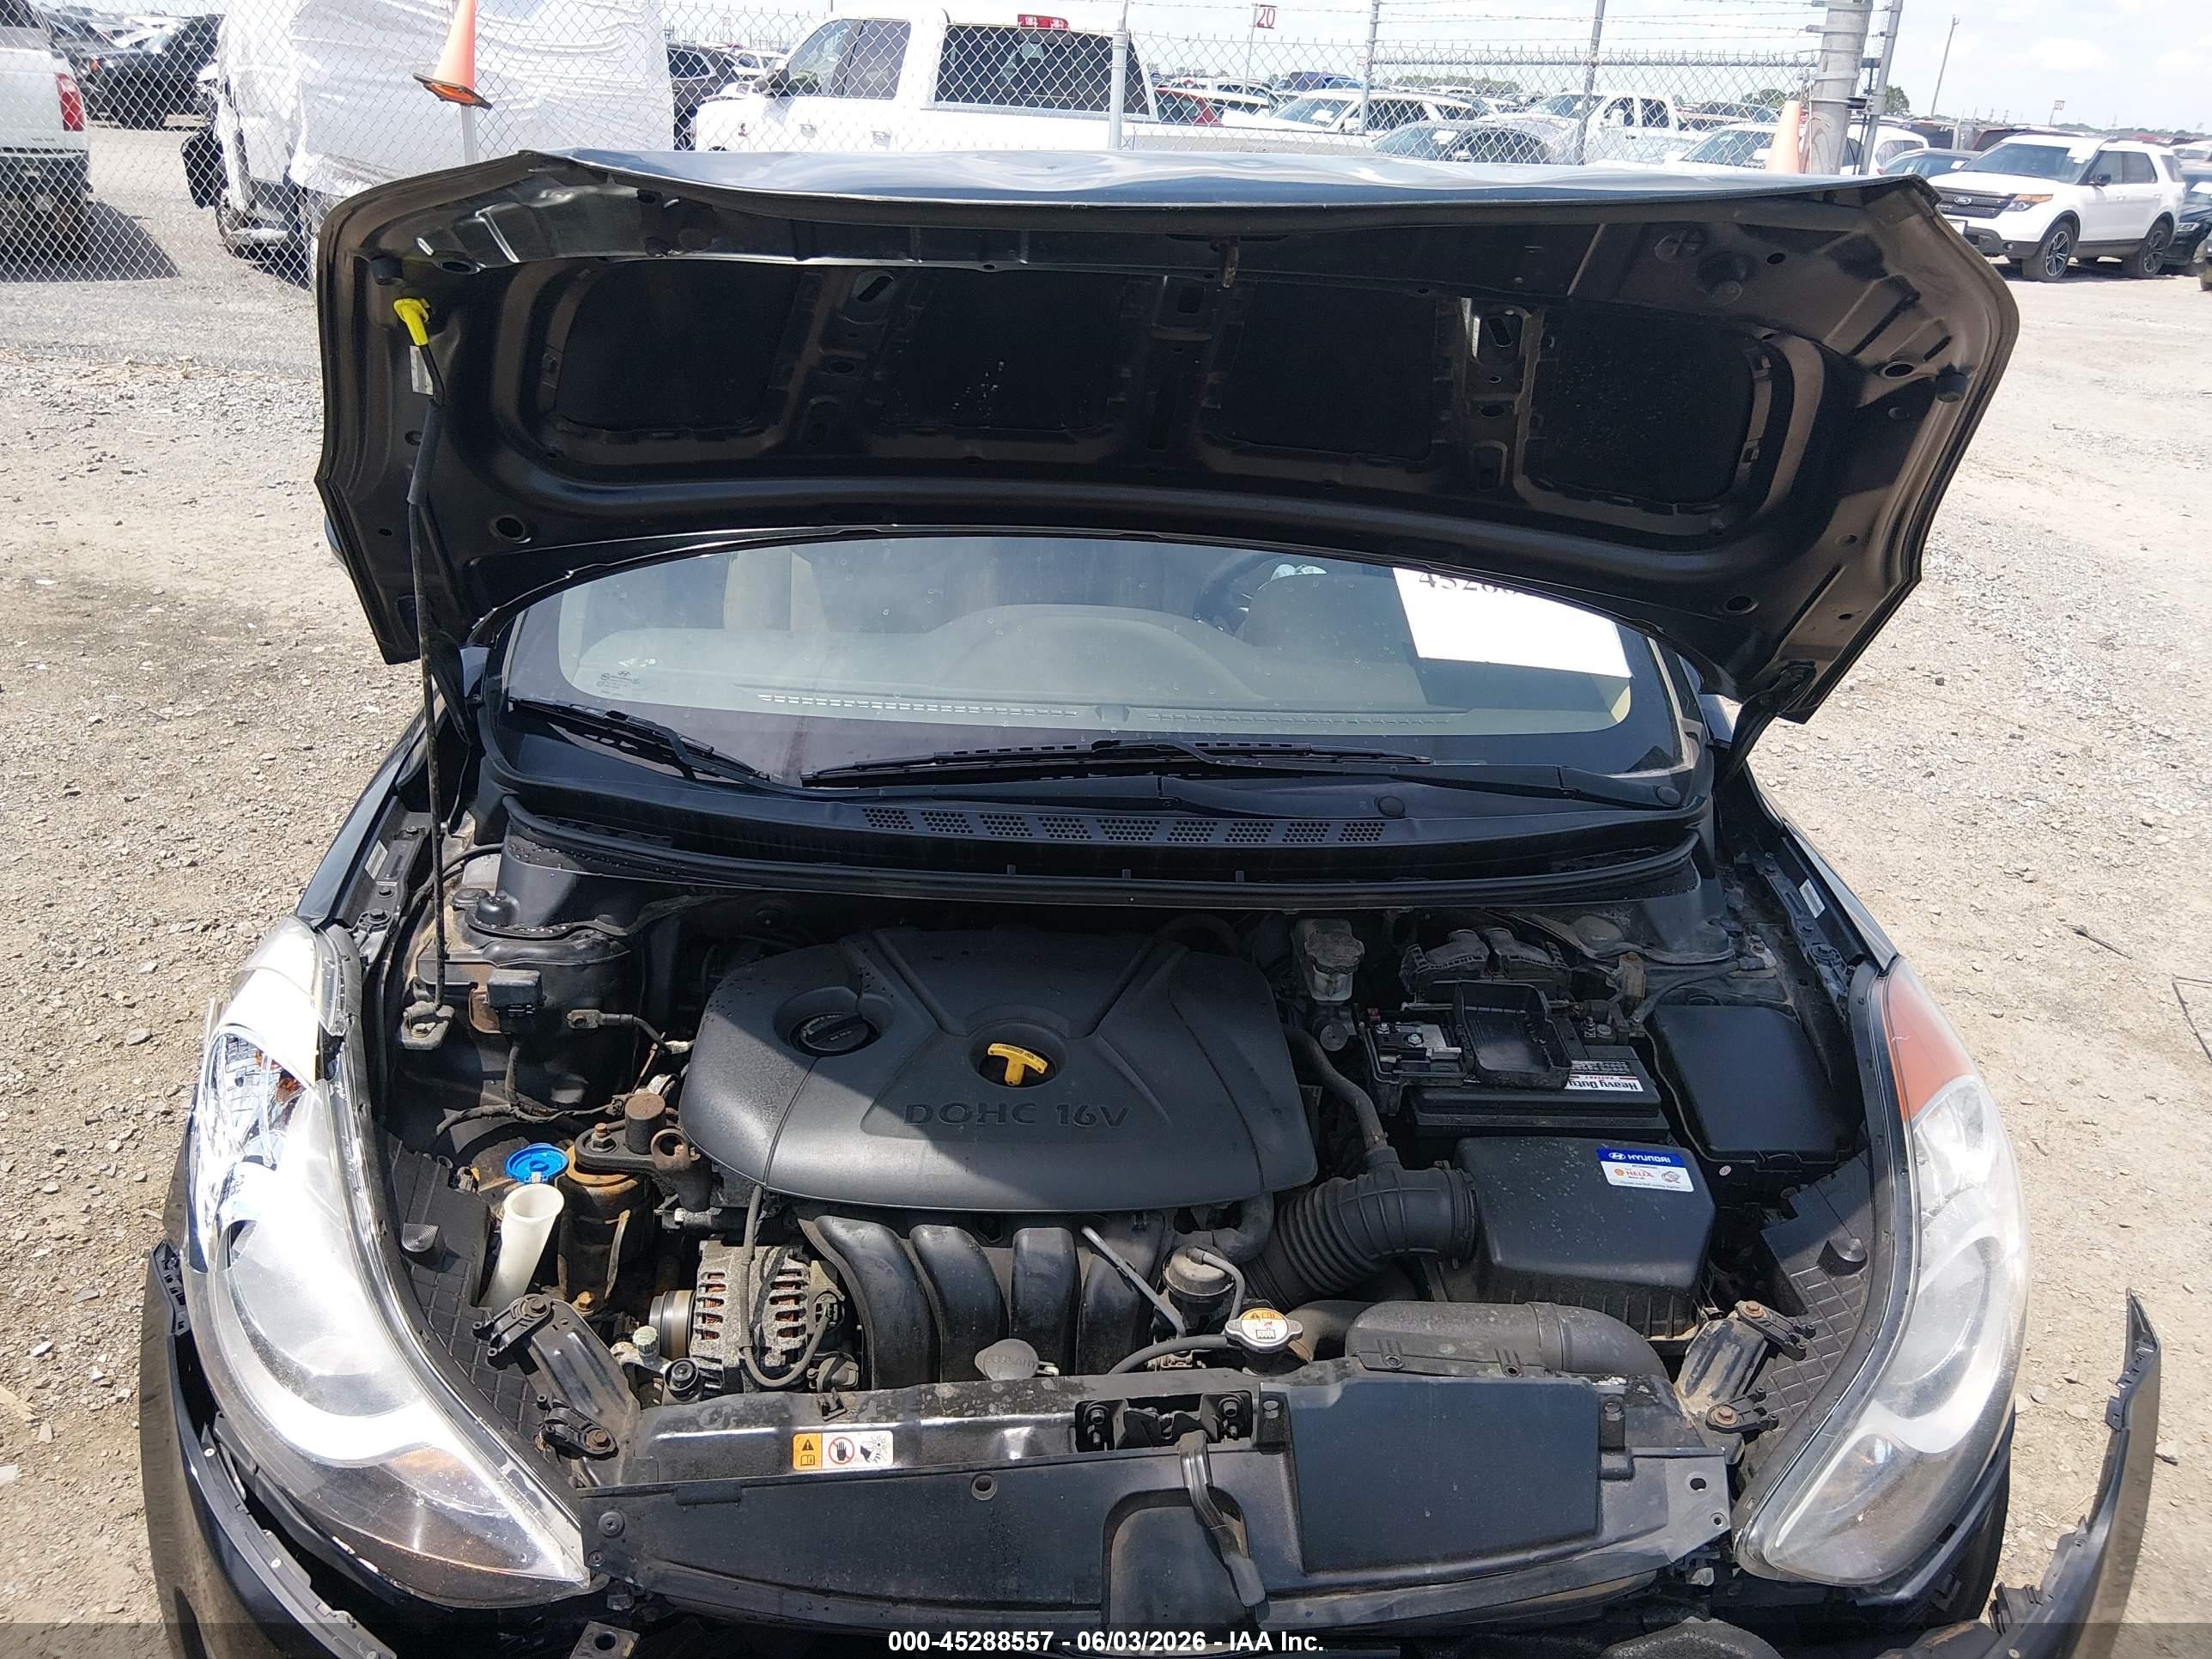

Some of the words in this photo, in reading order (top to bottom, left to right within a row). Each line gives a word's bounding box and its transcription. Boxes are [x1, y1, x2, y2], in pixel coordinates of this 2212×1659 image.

[1256, 8, 1276, 27] 20
[1568, 1079, 1598, 1089] Duty
[1600, 1080, 1638, 1090] Heavy
[902, 1102, 1036, 1127] DOHC
[1054, 1103, 1130, 1127] 16V
[1627, 1153, 1672, 1164] HYUNDAI
[1626, 1169, 1655, 1178] HELIX
